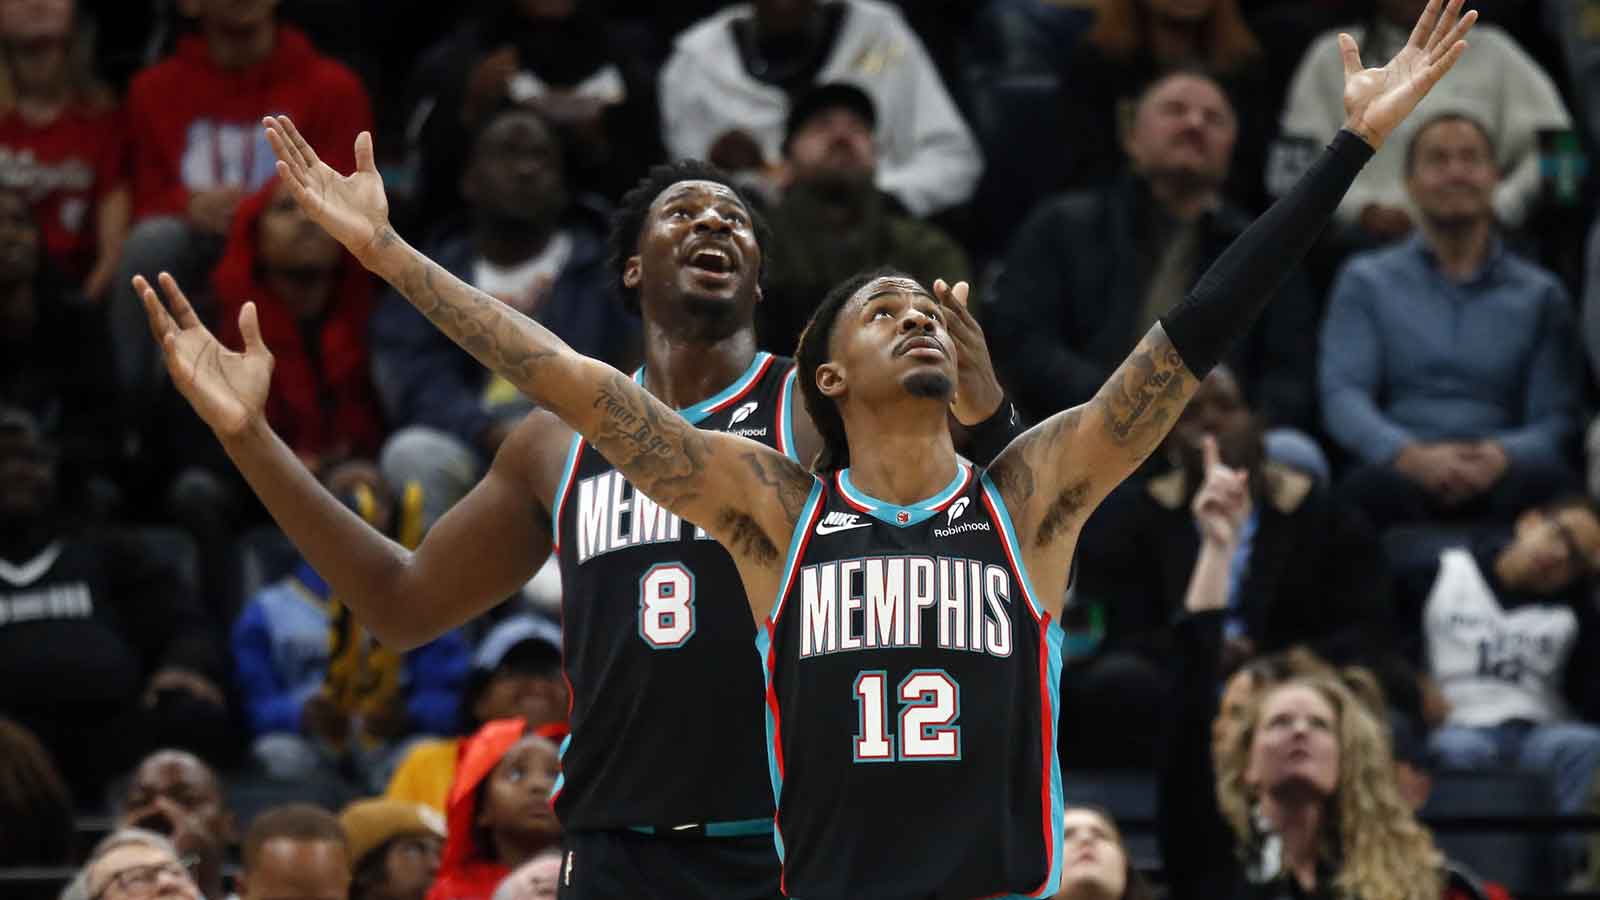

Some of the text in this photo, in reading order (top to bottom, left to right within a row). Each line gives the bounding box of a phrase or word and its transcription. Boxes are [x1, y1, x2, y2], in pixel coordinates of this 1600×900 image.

[824, 511, 860, 528] NIKE
[933, 521, 991, 539] Robinhood
[638, 561, 697, 650] 8
[800, 555, 1013, 660] MEMPHIS
[852, 668, 962, 763] 12
